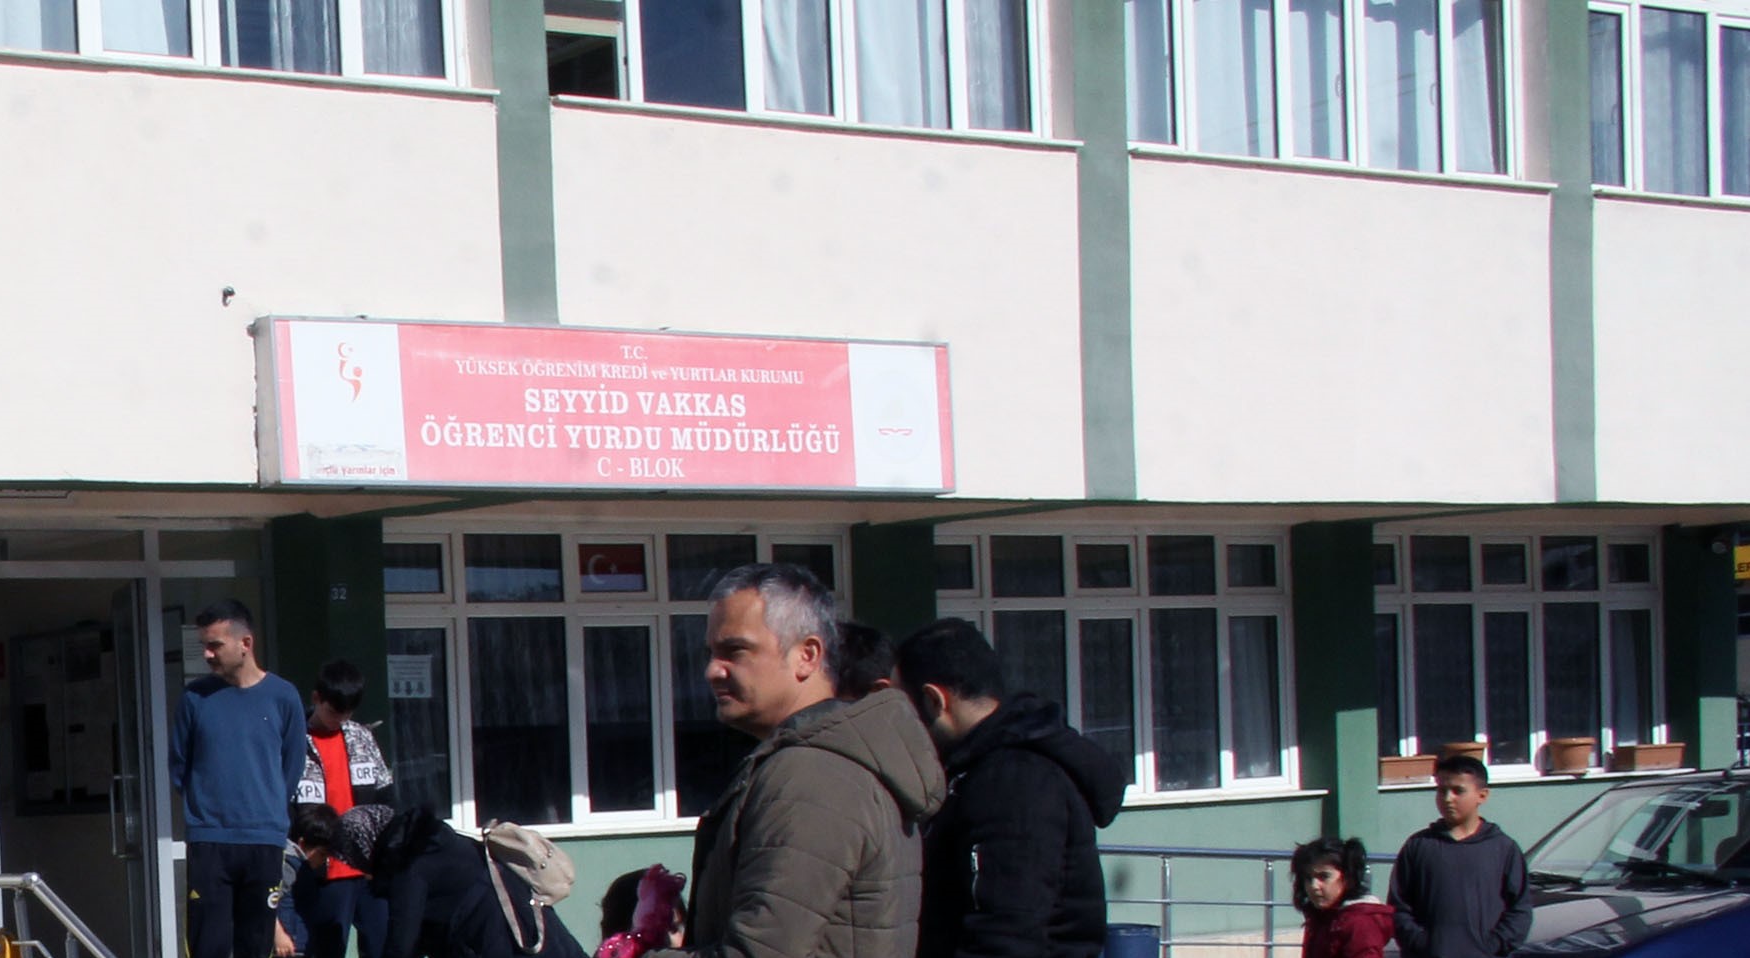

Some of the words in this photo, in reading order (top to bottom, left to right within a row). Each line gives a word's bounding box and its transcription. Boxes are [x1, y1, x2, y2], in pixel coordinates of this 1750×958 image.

[620, 345, 649, 360] T.C.
[455, 356, 519, 376] YÜKSEK
[521, 359, 597, 378] ÖĞRENİM
[601, 361, 648, 380] KREDİ
[652, 370, 667, 381] ve
[669, 366, 737, 383] YURTLAR
[741, 369, 804, 385] KURUMU
[524, 383, 629, 415] SEYYİD
[636, 391, 747, 418] VAKKAS
[420, 414, 558, 449] ÖĞRENCİ
[564, 424, 662, 451] YURDU
[670, 420, 840, 454] MÜDÜRLÜĞÜ
[596, 456, 611, 477] C
[629, 456, 685, 478] BLOK
[330, 586, 348, 601] 32
